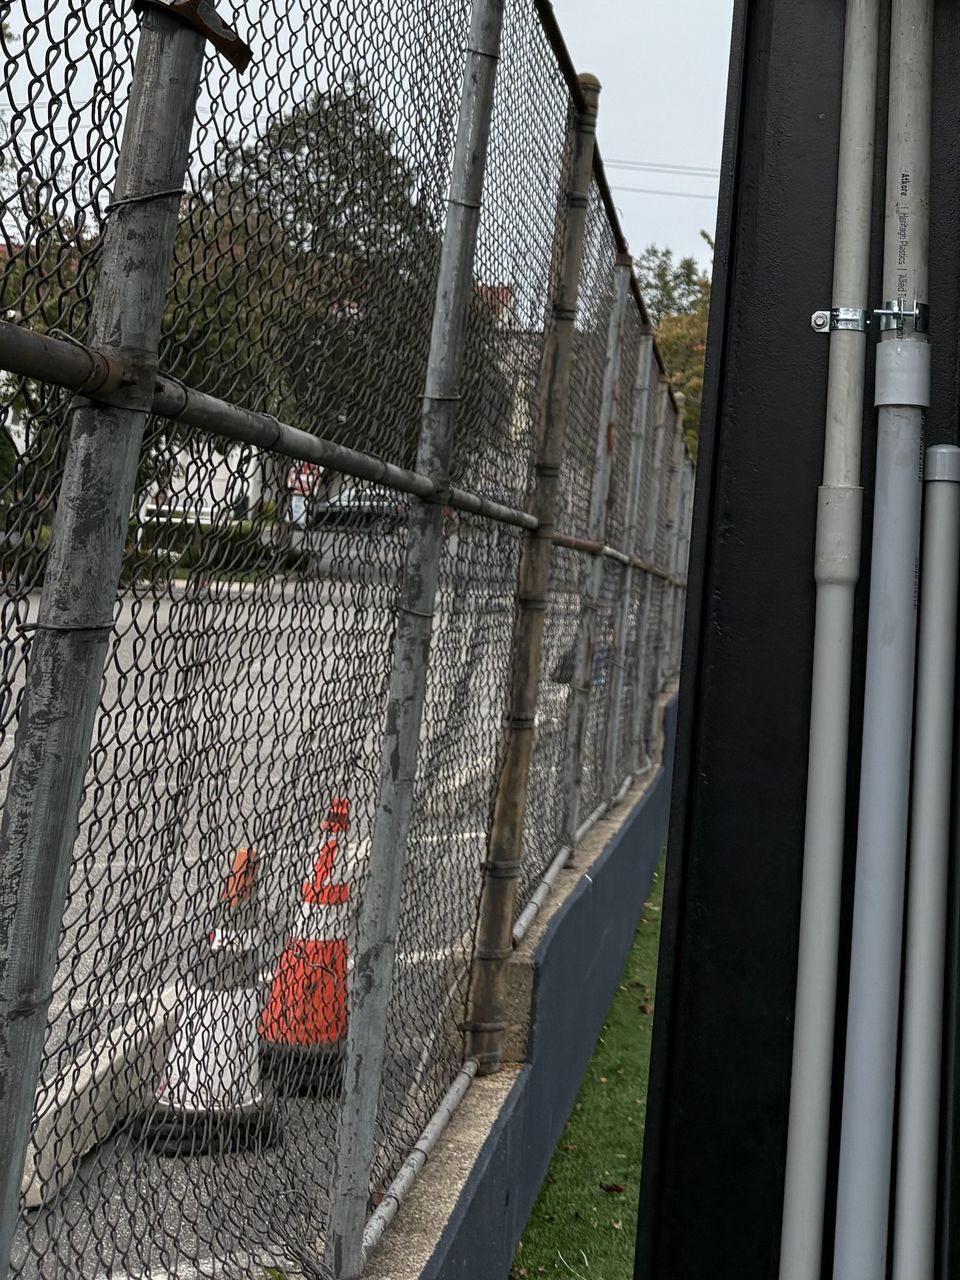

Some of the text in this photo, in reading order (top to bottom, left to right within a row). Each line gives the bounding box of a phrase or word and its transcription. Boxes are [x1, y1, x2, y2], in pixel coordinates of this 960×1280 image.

[900, 173, 910, 196] Atkore
[897, 213, 909, 240] Heritage
[898, 240, 908, 265] Plastics
